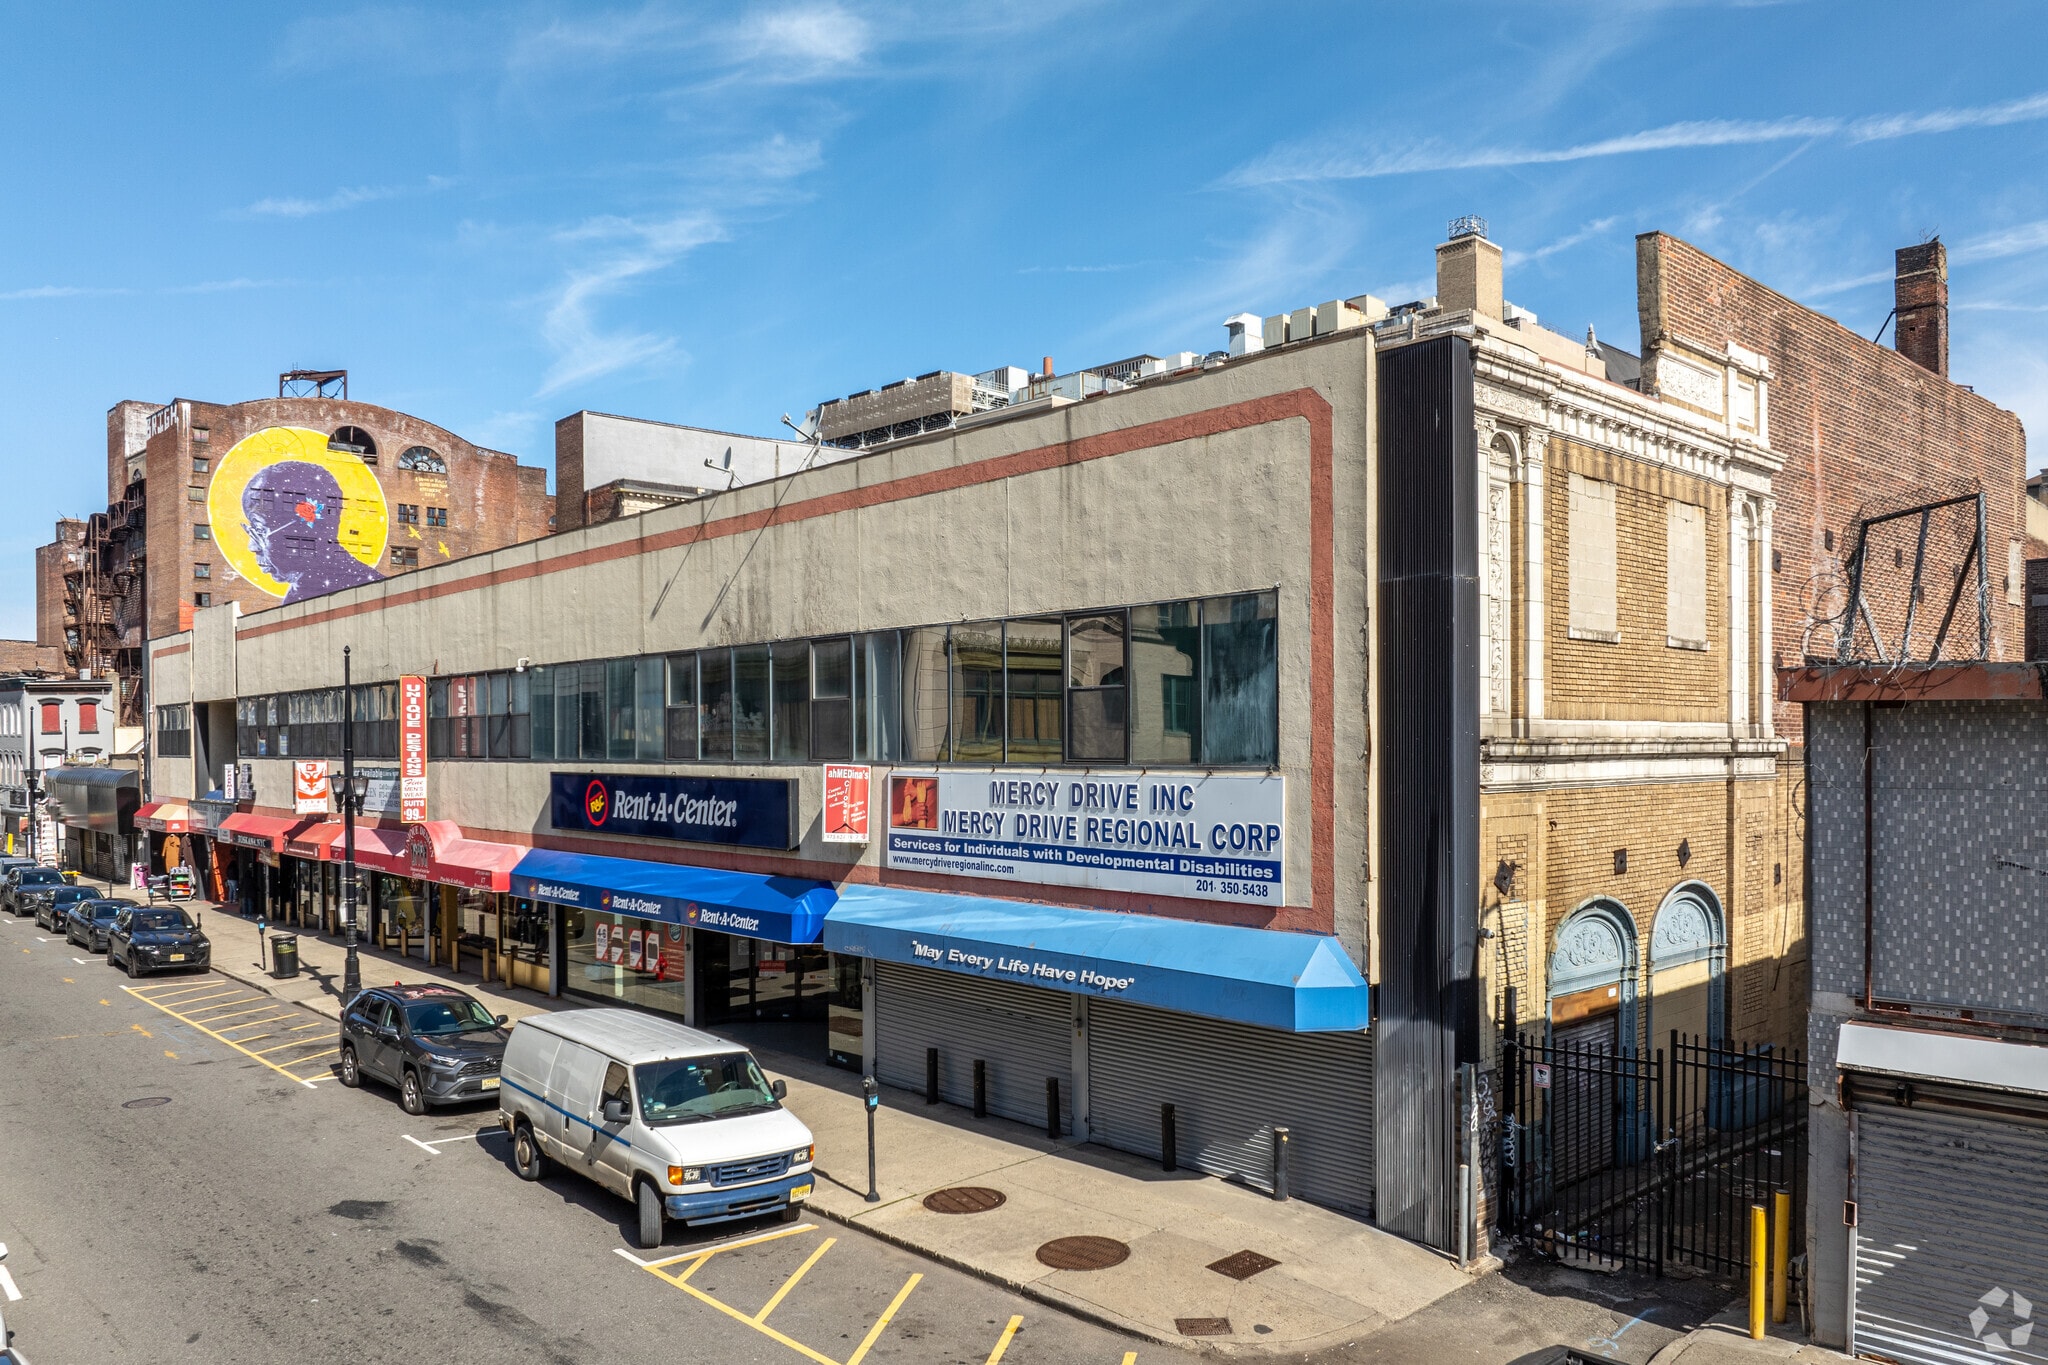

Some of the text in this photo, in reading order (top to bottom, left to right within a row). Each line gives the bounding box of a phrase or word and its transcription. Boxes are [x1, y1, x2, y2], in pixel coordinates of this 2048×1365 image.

[405, 684, 422, 777] UNIQUE DESIGNS
[828, 768, 869, 780] ahMEDina's
[991, 779, 1195, 811] MERCY DRIVE INC
[943, 809, 1282, 853] MERCY DRIVE REGIONAL CORP
[892, 854, 1015, 875] www.mercydriveregionalinc.com
[893, 837, 1274, 879] Services for Individuals with Developmental Disabilities
[911, 940, 1135, 991] "May Every Life Have Hope"
